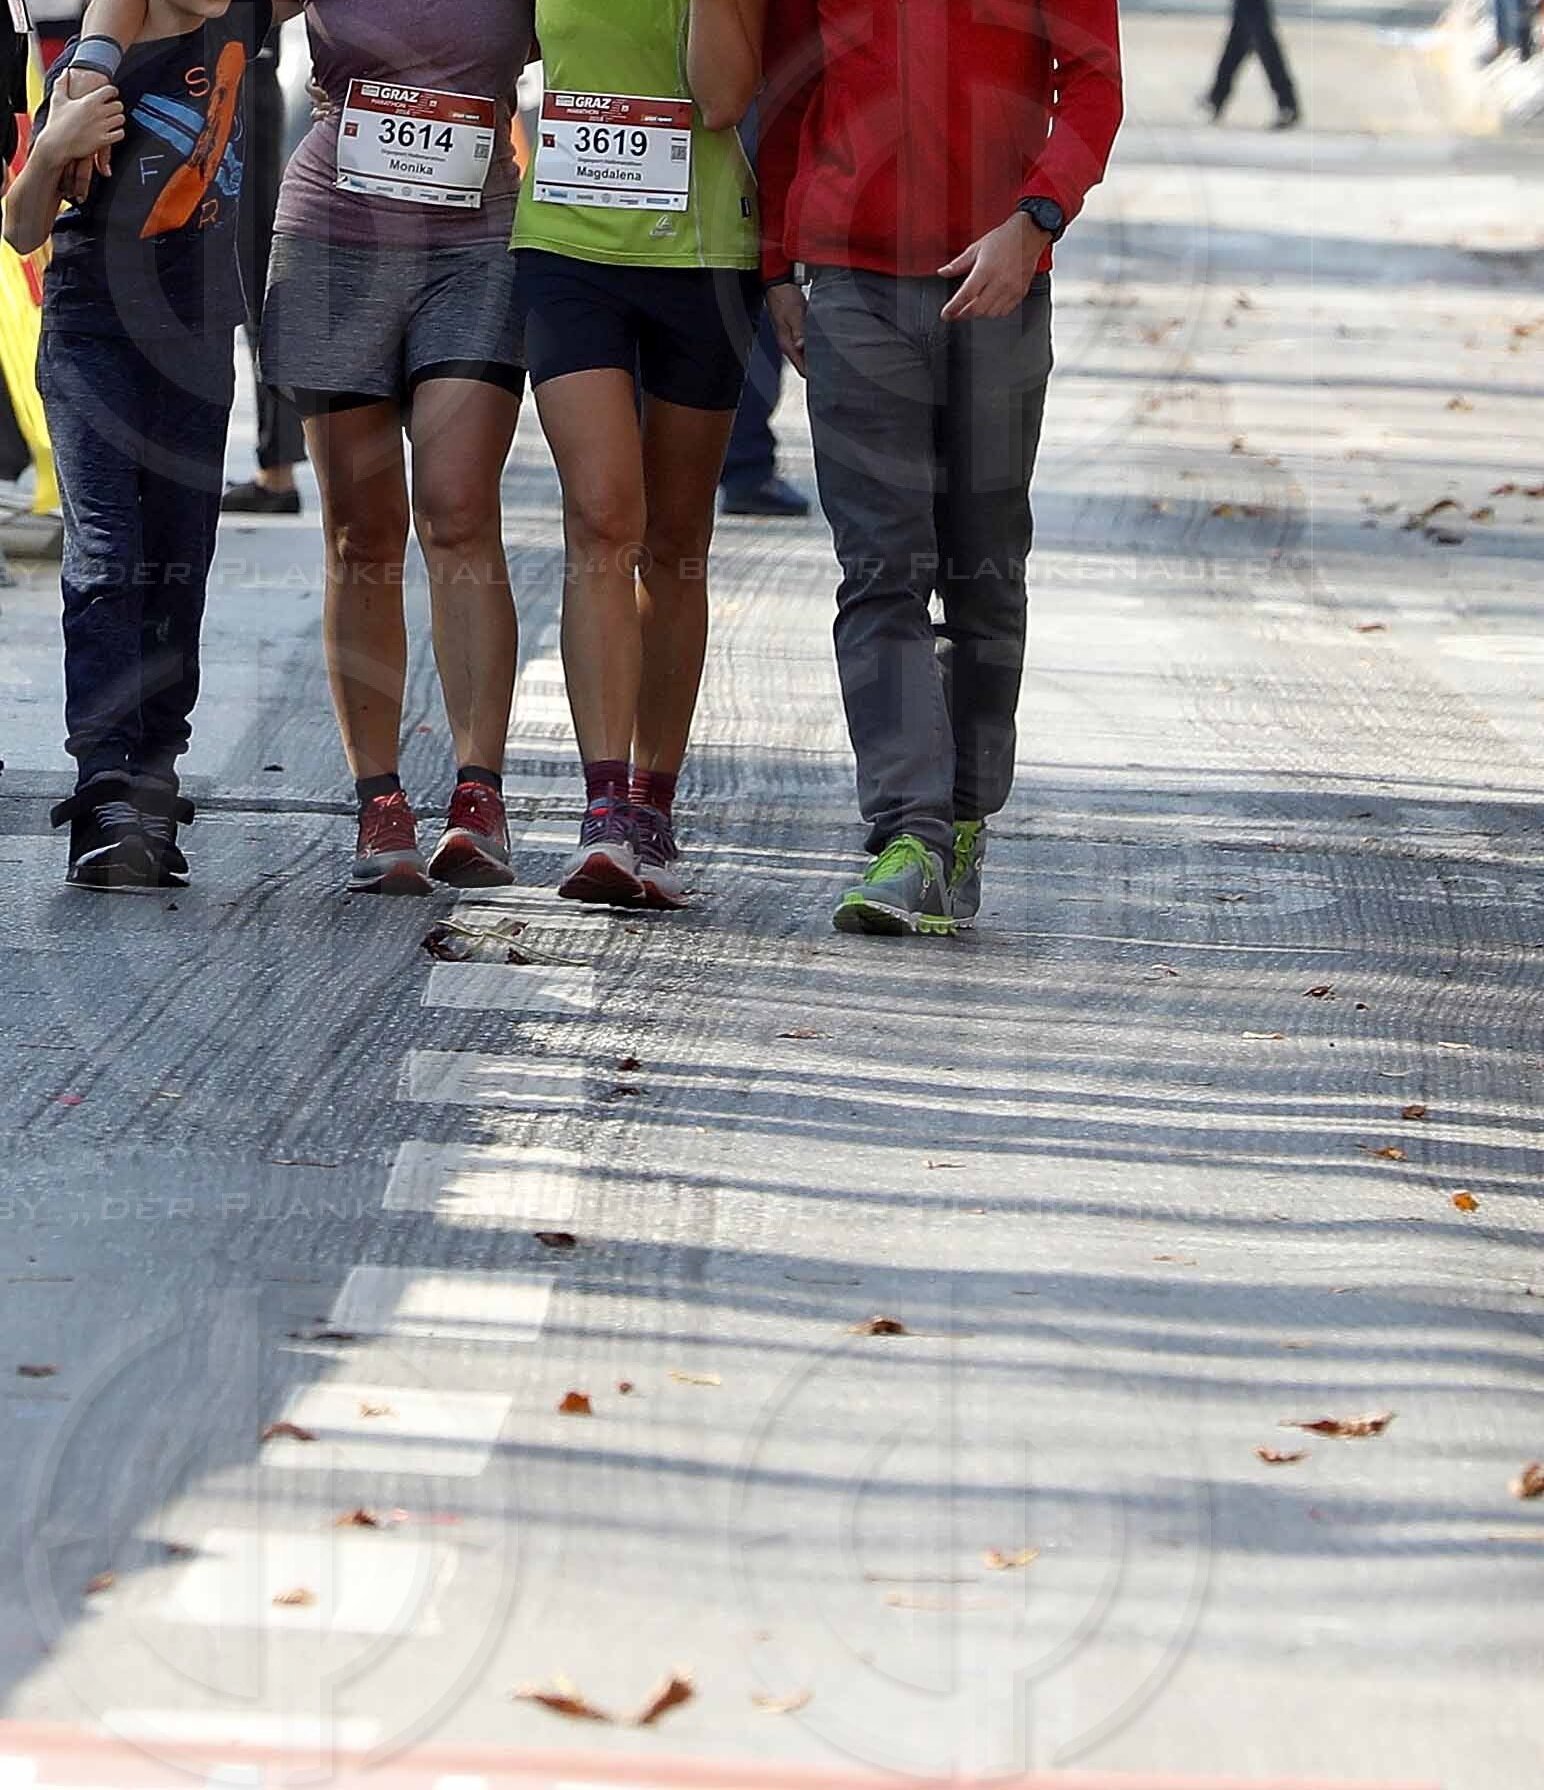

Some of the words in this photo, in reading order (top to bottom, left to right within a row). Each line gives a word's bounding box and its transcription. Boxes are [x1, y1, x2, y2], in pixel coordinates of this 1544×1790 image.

[380, 87, 420, 103] GRAZ
[575, 96, 612, 110] GRAZ
[378, 118, 454, 153] 3614
[574, 126, 648, 157] 3619
[389, 159, 434, 175] Monika
[576, 166, 642, 181] Magdalena
